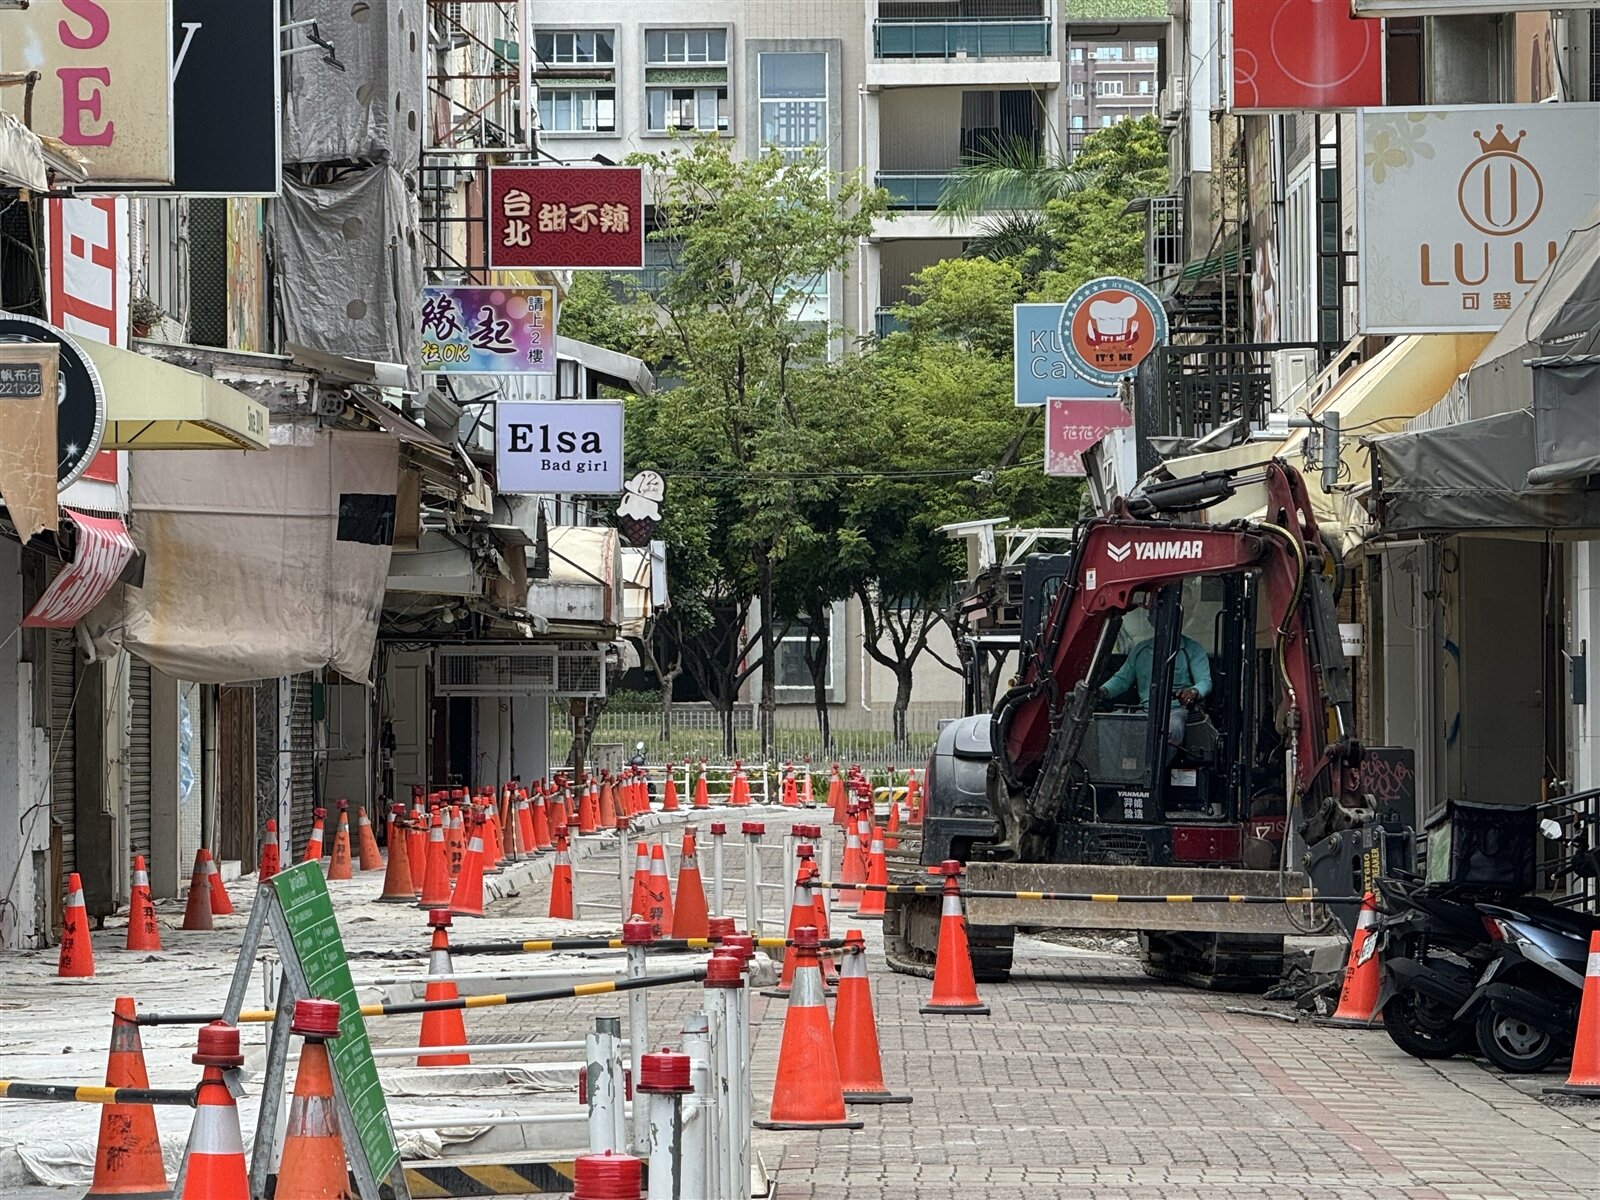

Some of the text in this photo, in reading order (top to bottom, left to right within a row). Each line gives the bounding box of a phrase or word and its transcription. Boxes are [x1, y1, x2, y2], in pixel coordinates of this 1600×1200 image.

[503, 189, 532, 247] 台北
[538, 203, 630, 234] 甜不辣
[1462, 292, 1530, 311] 可愛
[421, 293, 517, 354] 緣起
[527, 296, 544, 364] 請上2樓
[1030, 356, 1080, 380] Ca
[1095, 353, 1133, 362] IT'S ME
[508, 423, 602, 454] Elsa
[1063, 425, 1122, 440] 花花公
[541, 459, 608, 474] Bad girl
[1134, 540, 1203, 560] YANMAR
[1117, 790, 1150, 798] YANMAR
[1363, 853, 1371, 892] RT680
[1371, 848, 1380, 881] REAKER
